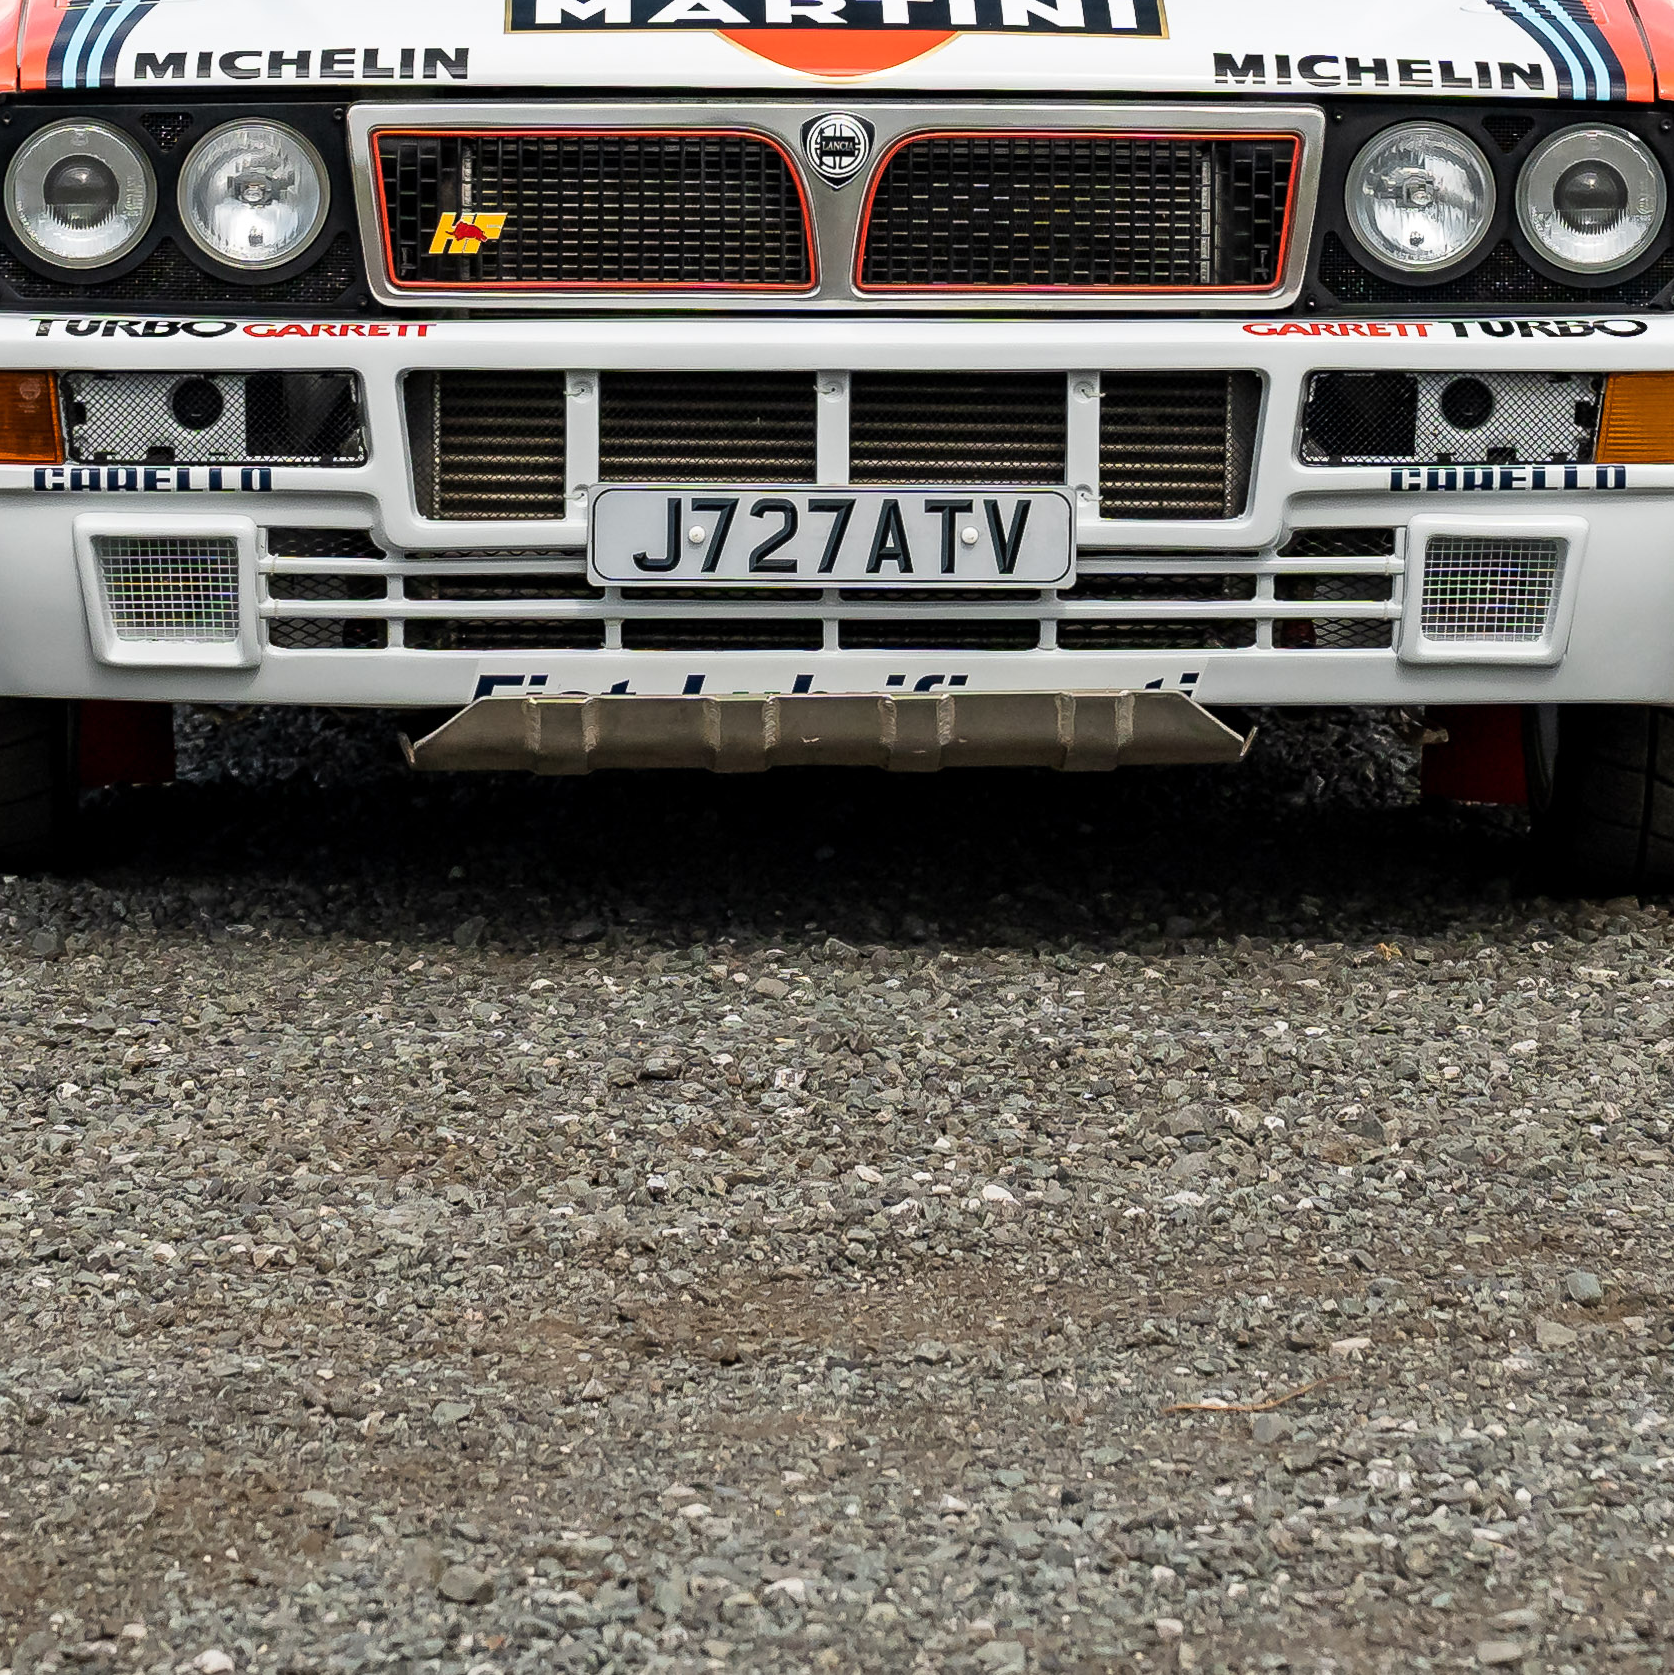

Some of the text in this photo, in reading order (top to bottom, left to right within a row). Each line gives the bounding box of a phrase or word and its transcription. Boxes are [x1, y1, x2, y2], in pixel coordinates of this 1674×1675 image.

[133, 47, 470, 80] MICHELIN
[1213, 52, 1545, 91] MICHELIN
[821, 141, 855, 152] LANCIA
[428, 211, 509, 255] HF
[29, 318, 437, 338] TURBO GARRETT
[1242, 318, 1648, 339] GARRETT TURBO
[33, 466, 273, 492] CARELLO
[1389, 465, 1626, 491] CARELLO
[632, 497, 1032, 575] J727ATV
